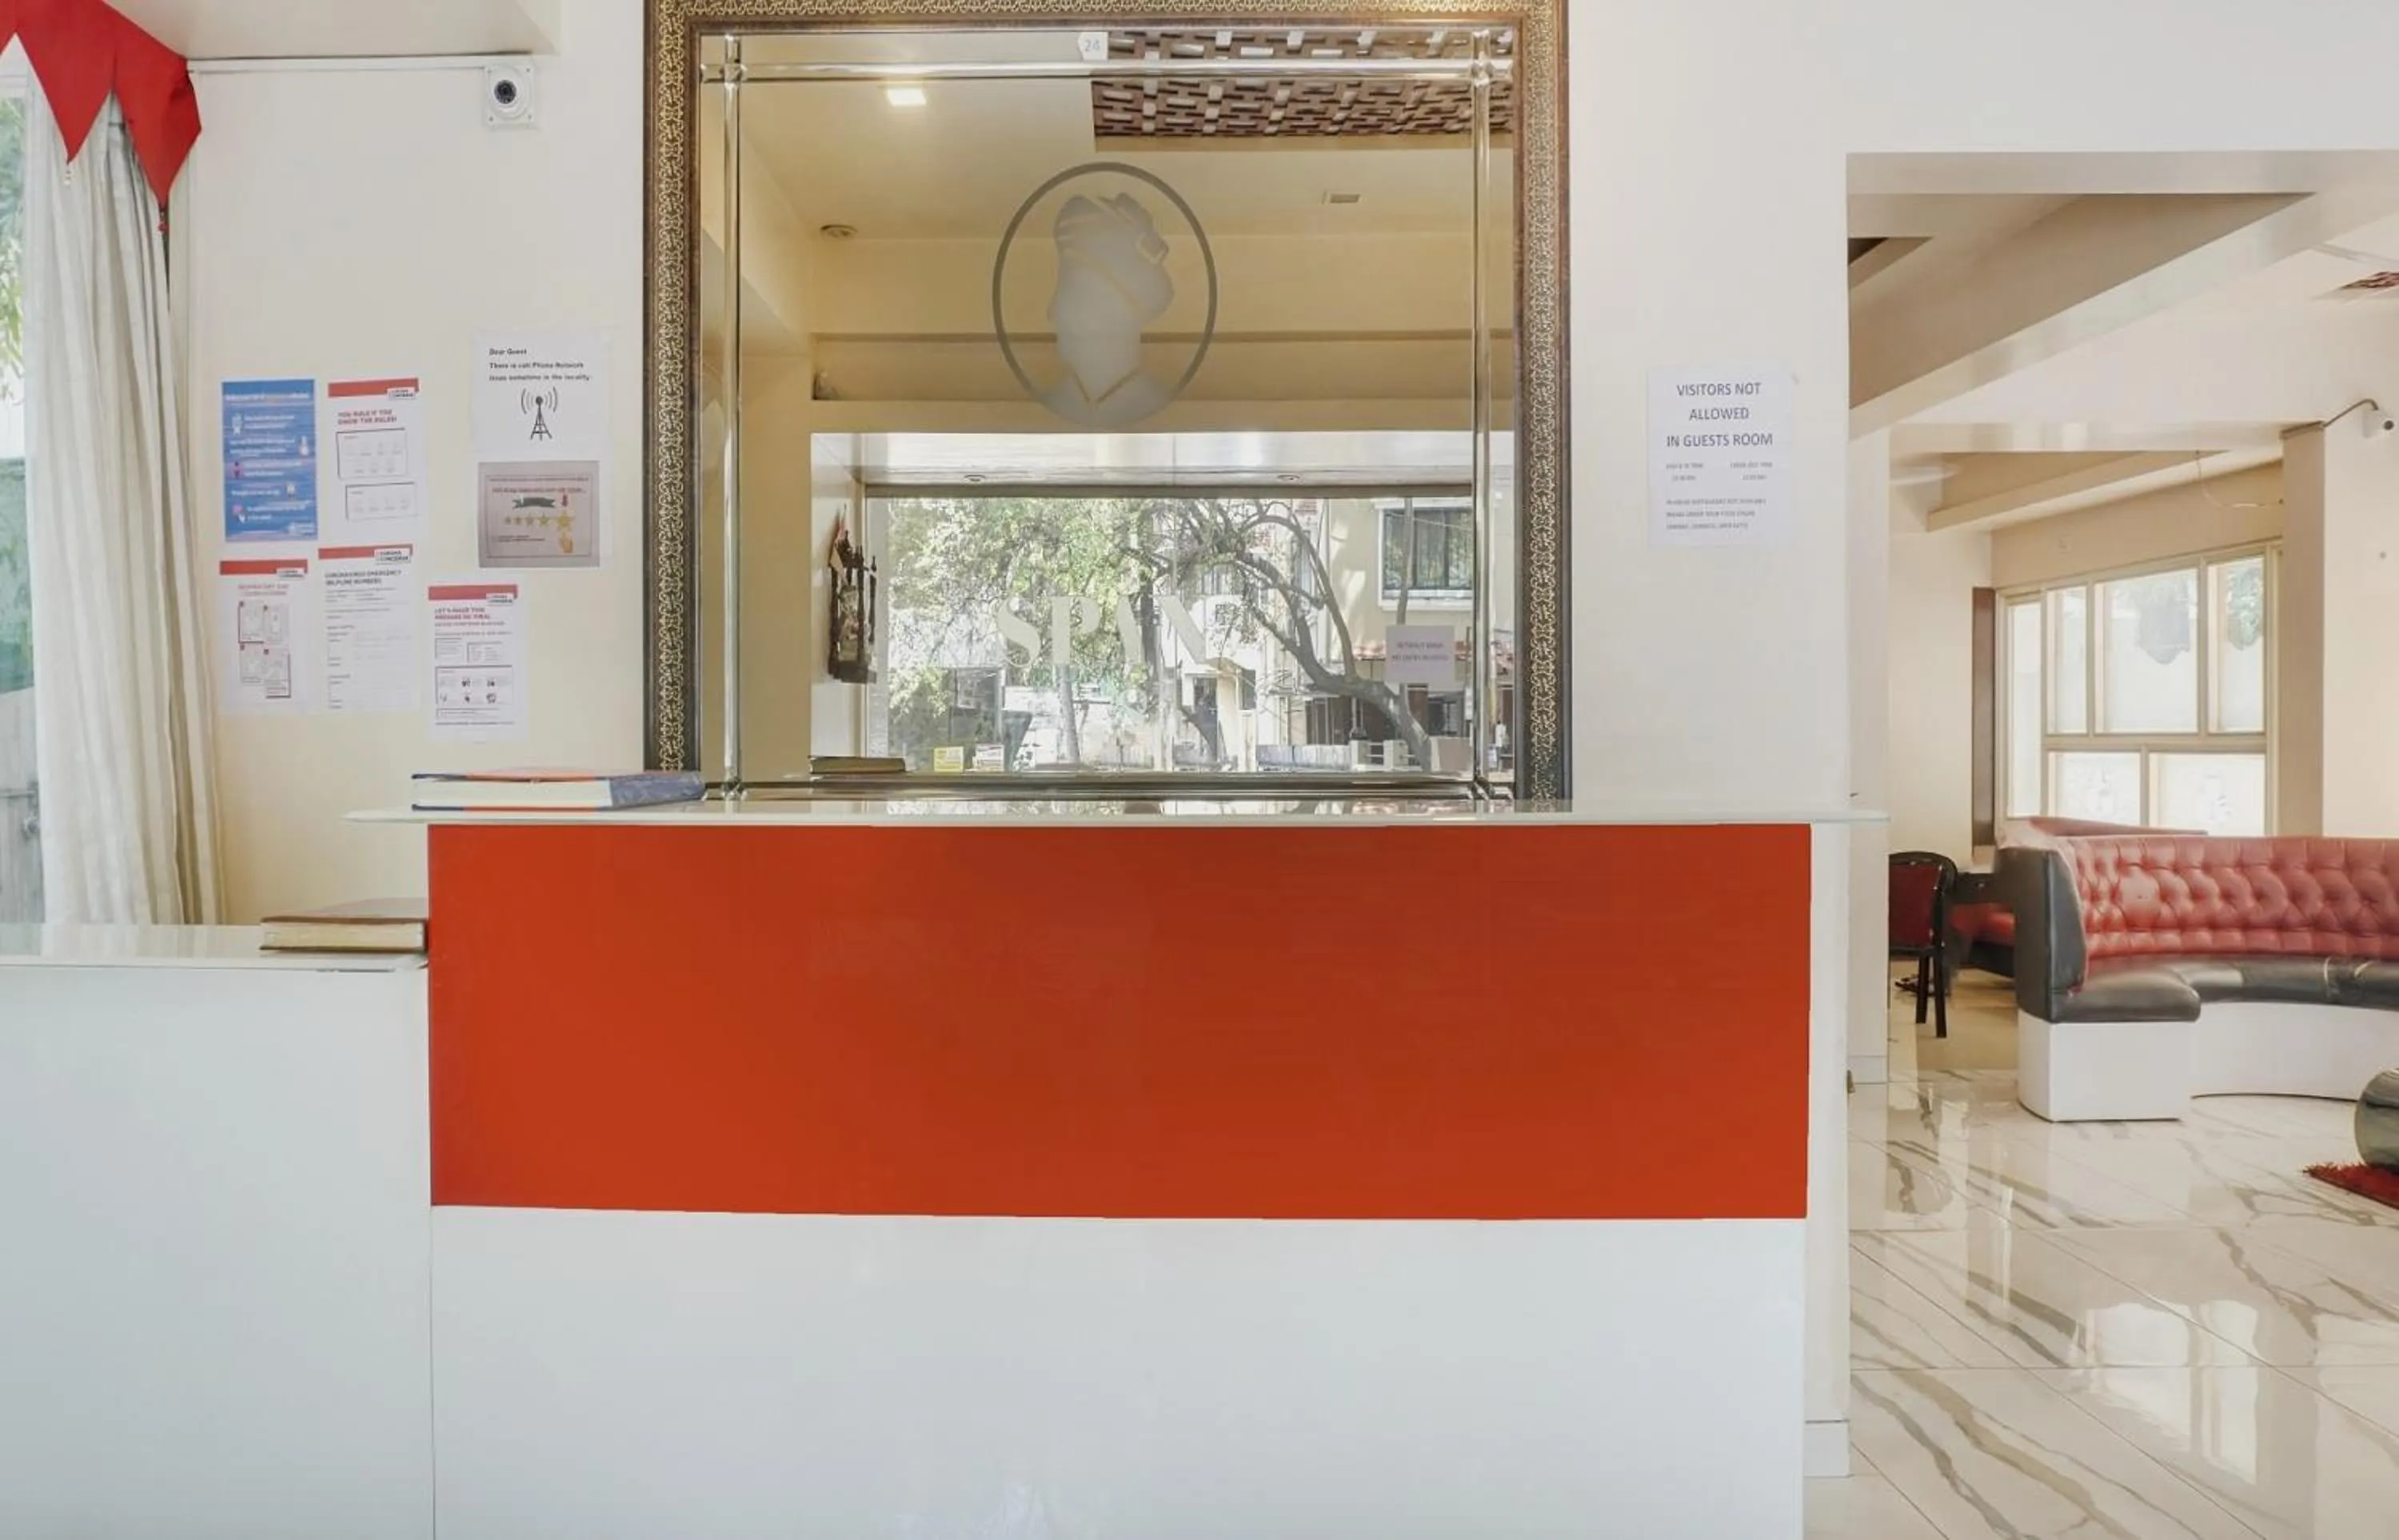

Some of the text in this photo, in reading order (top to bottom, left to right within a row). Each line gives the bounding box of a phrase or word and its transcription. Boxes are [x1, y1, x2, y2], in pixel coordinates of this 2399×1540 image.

[1677, 382, 1762, 397] VISITORS NOT
[1689, 407, 1750, 421] ALLOWED
[1667, 433, 1773, 447] IN GUESTS ROOM
[993, 593, 1243, 669] SPAN
